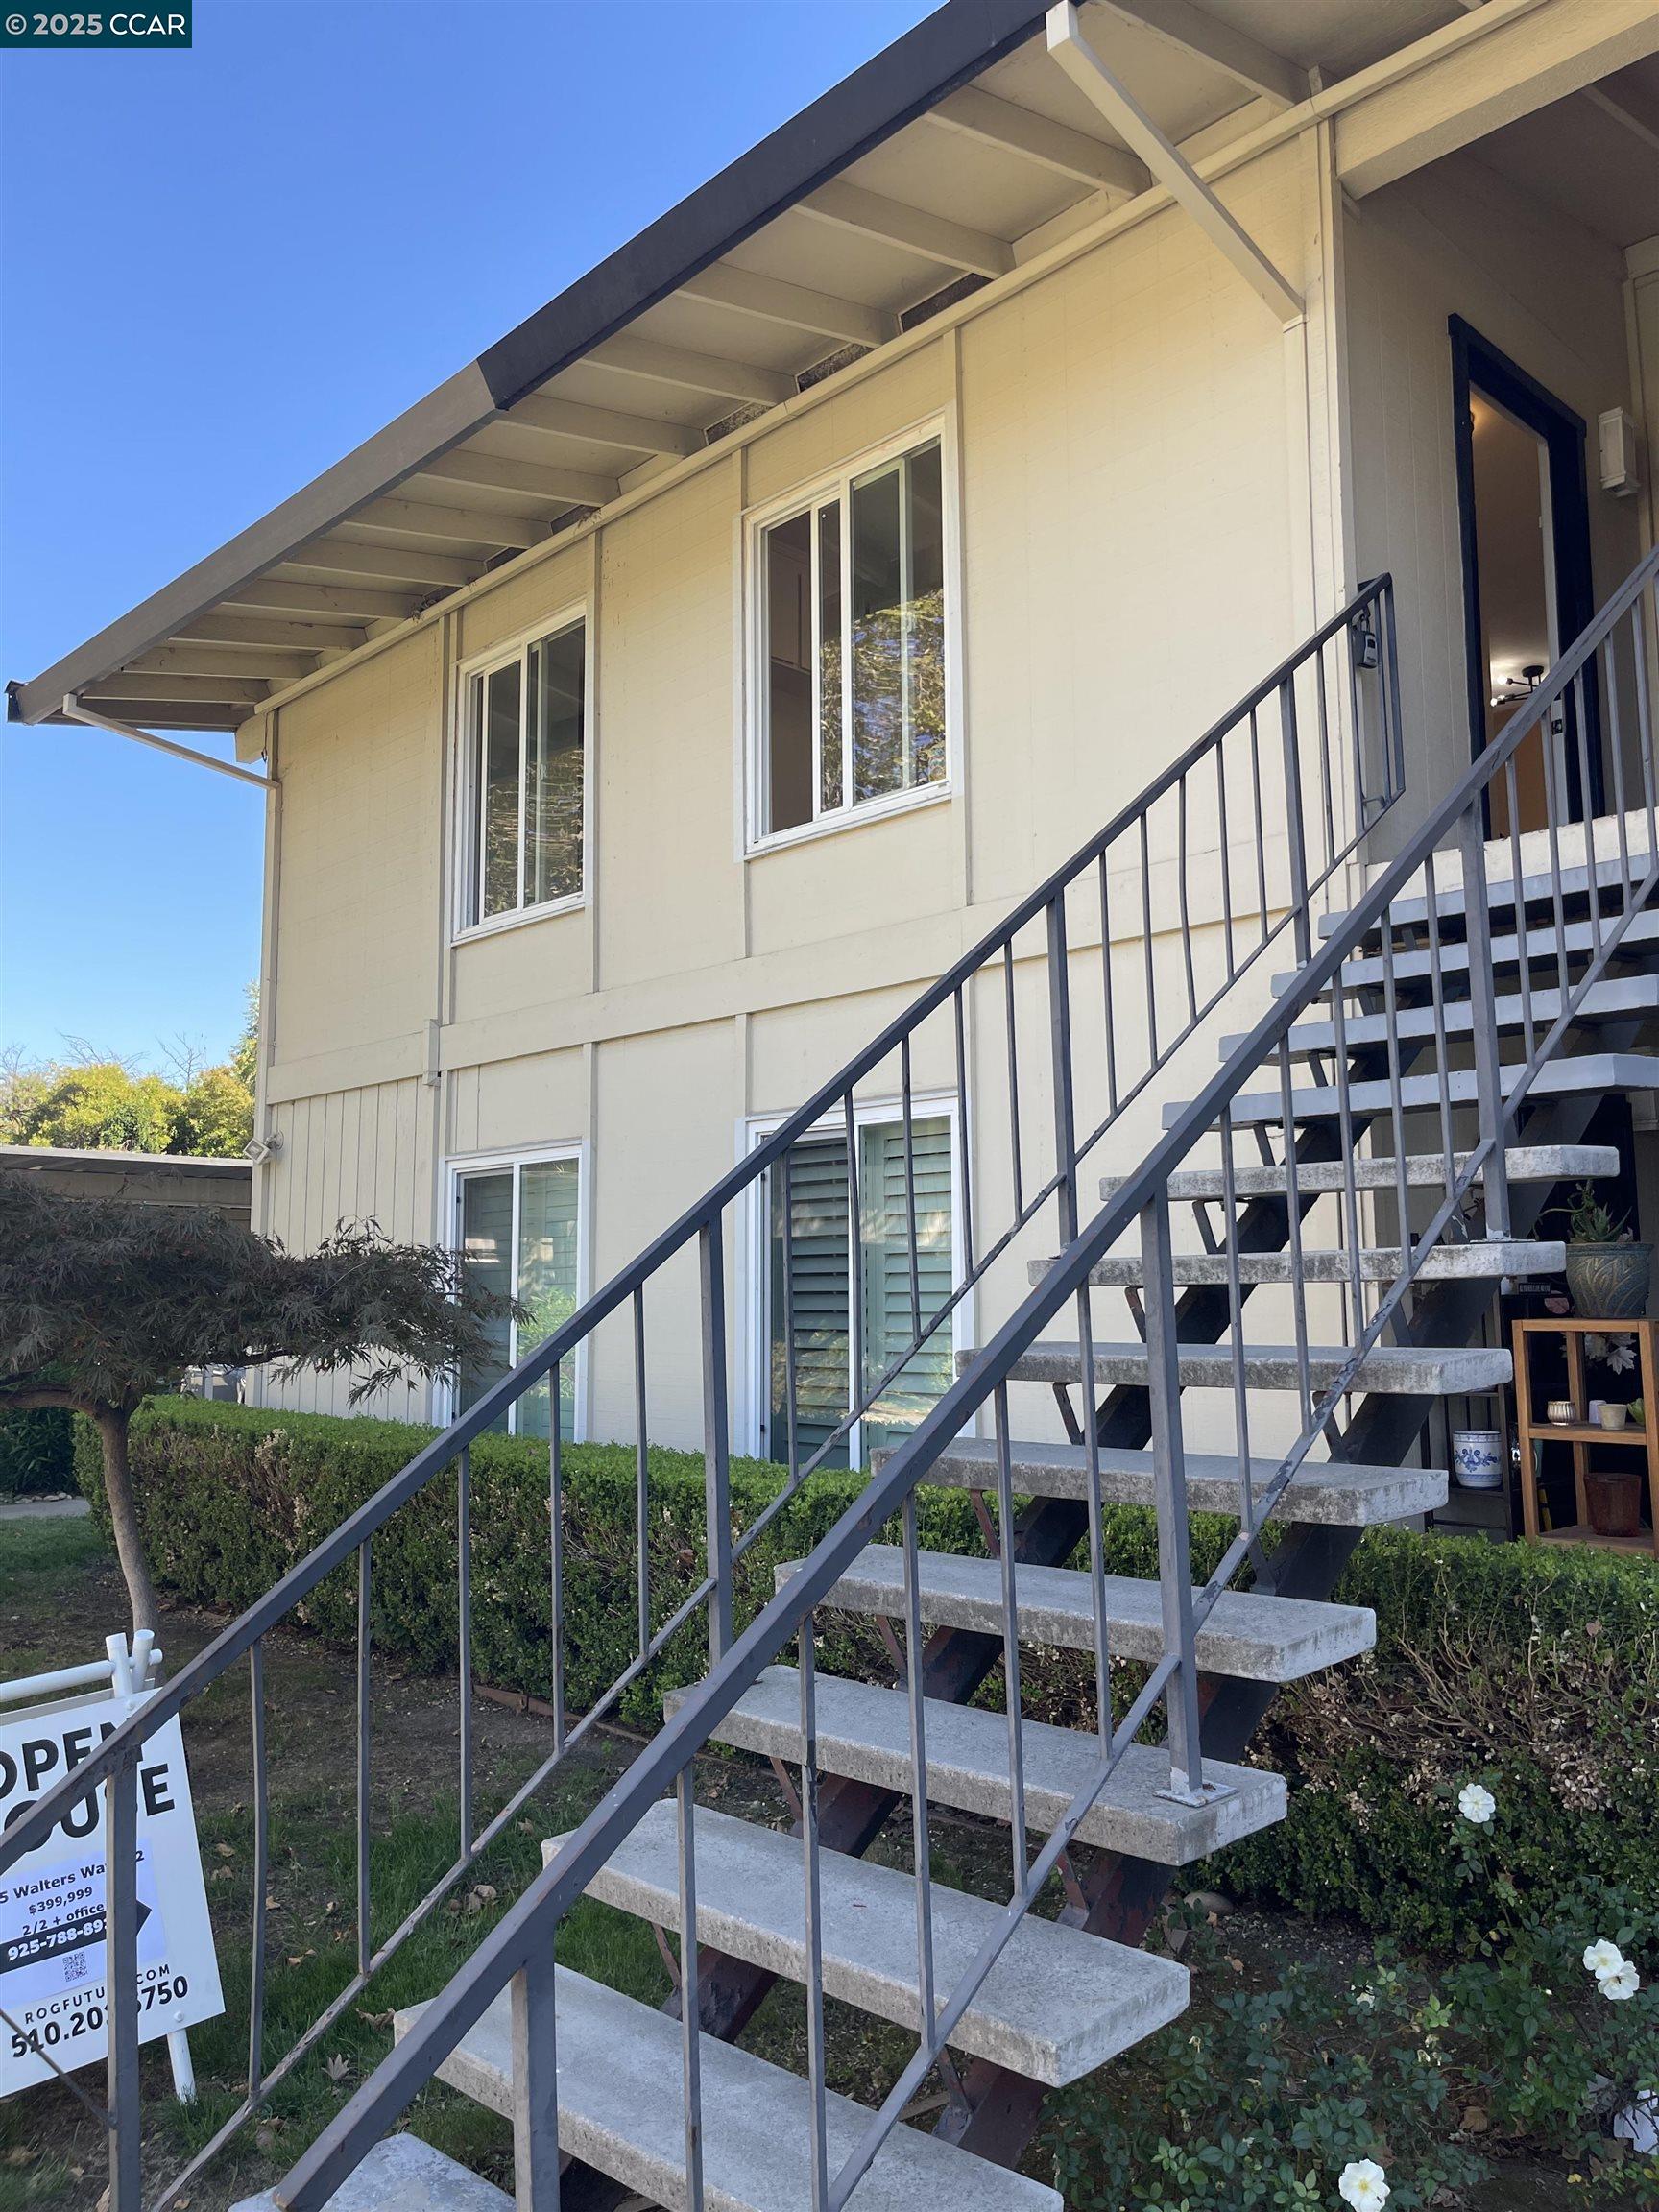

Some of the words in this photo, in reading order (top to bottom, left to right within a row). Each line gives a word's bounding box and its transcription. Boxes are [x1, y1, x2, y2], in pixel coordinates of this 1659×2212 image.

[13, 1873, 76, 1899] Walters
[80, 1863, 107, 1879] Wa
[29, 1887, 93, 1915] $399,999
[22, 1919, 48, 1936] 2/2
[53, 1916, 61, 1926] +
[66, 1902, 105, 1922] office
[8, 1919, 107, 1960] 925-788-89
